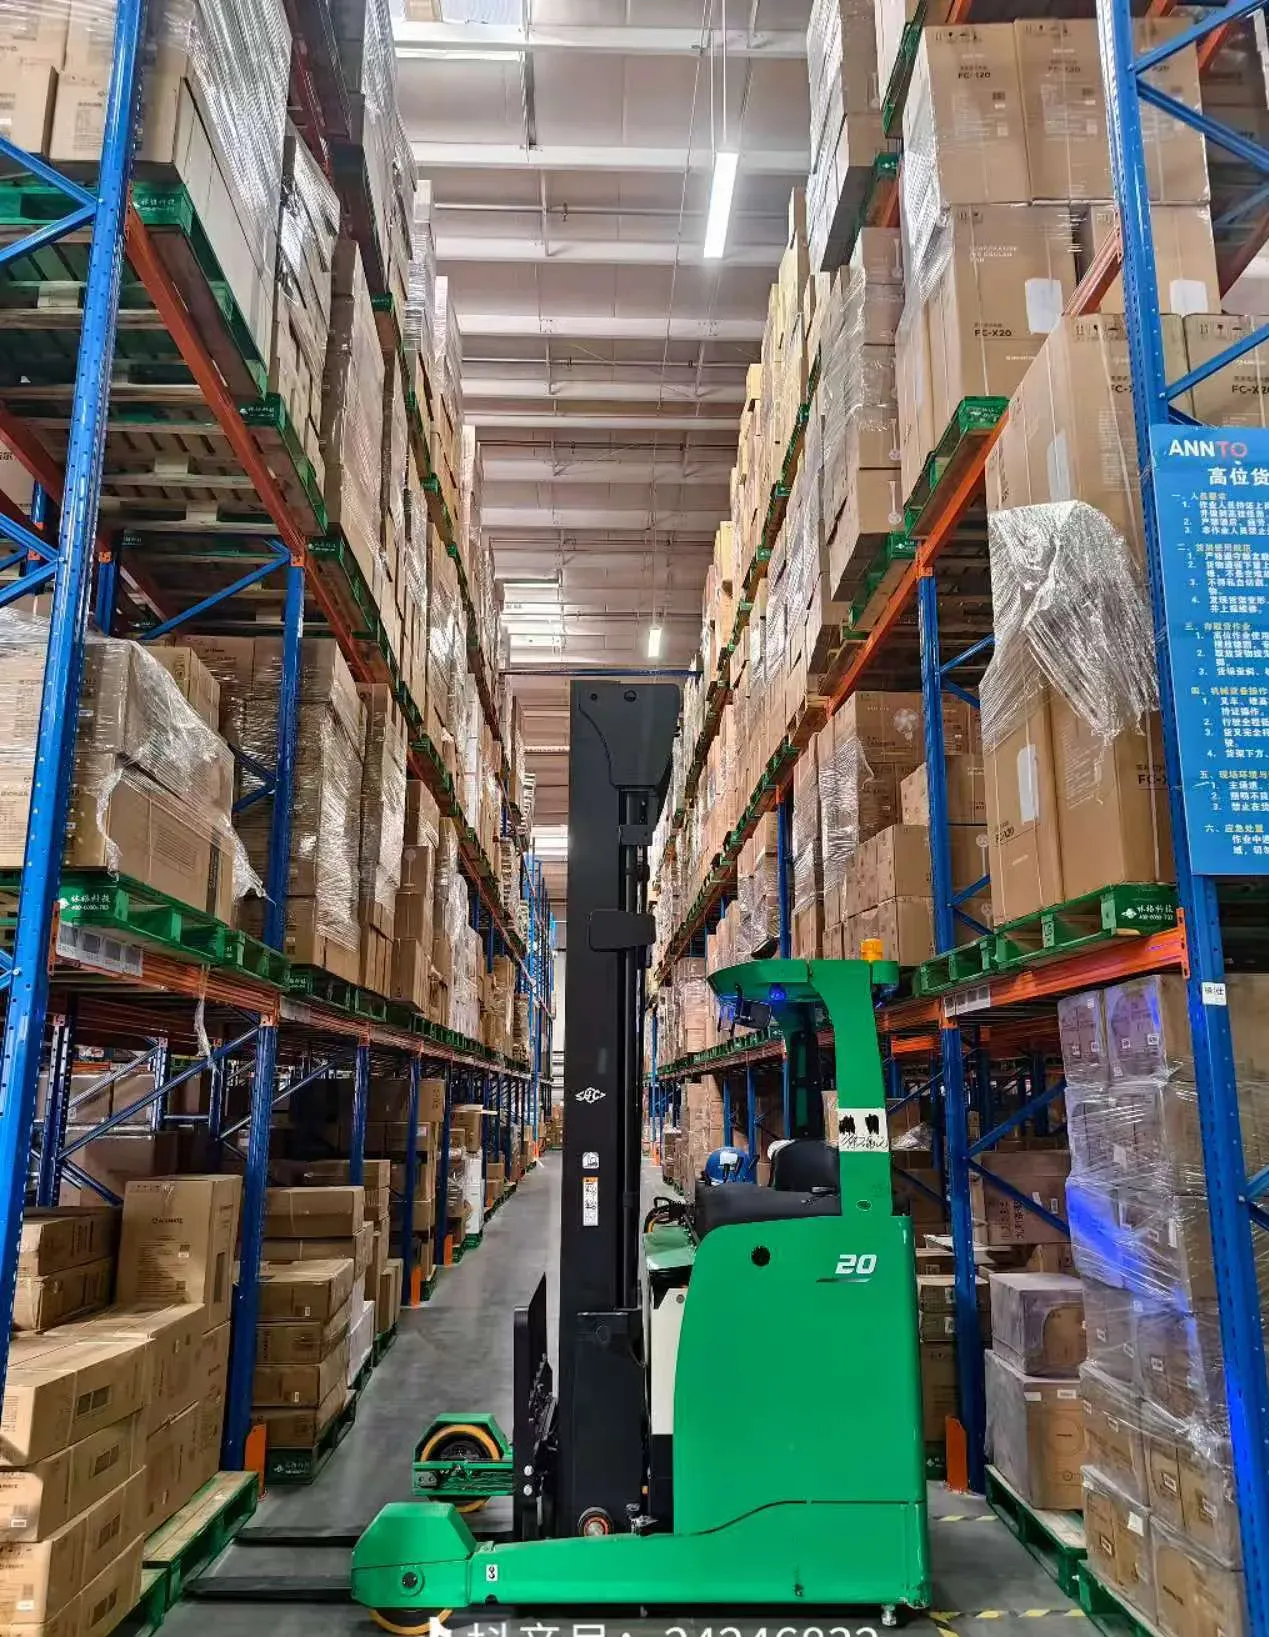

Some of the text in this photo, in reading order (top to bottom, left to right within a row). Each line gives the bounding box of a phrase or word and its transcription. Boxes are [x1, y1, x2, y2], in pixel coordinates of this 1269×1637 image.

[974, 329, 1012, 337] FC-X20
[1168, 439, 1248, 458] ANNTO
[835, 1254, 877, 1275] 20
